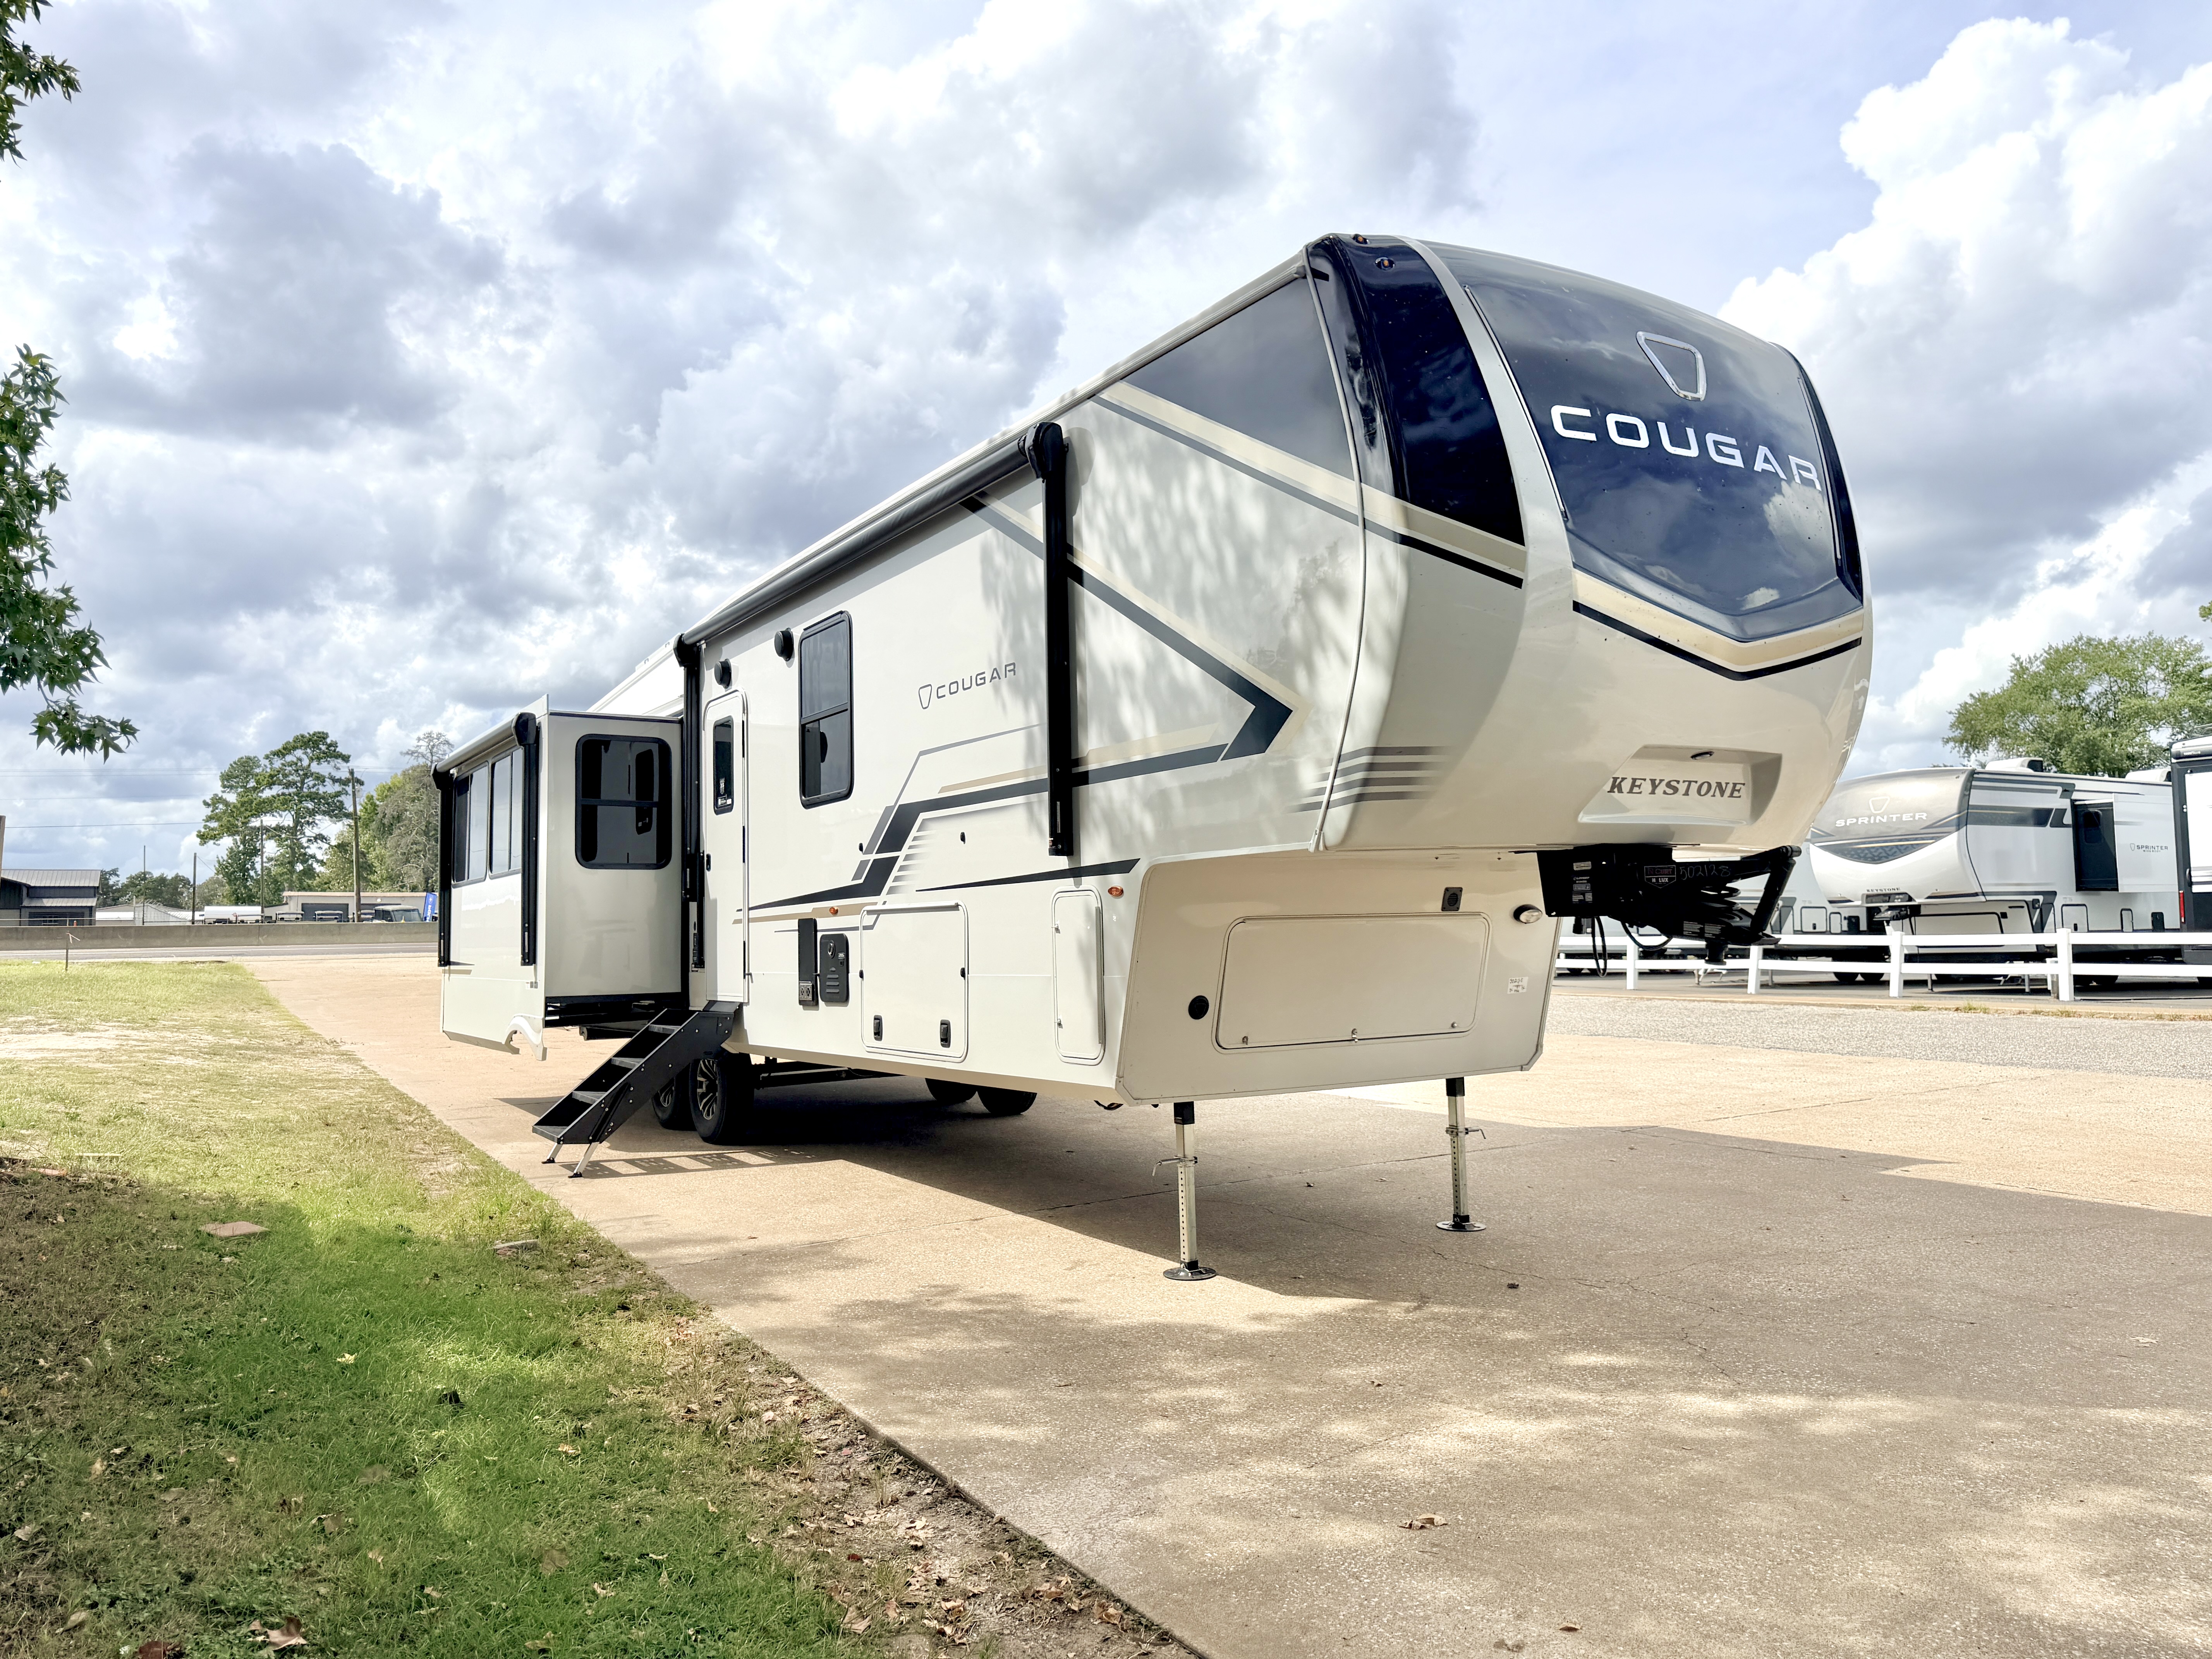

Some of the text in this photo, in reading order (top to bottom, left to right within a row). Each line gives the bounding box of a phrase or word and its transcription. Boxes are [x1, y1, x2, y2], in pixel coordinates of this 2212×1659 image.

[1551, 405, 1822, 492] COUGAR
[936, 662, 1017, 699] COUGAR
[1607, 776, 1746, 799] KEYSTONE
[1835, 812, 1927, 827] SPRINTER
[1680, 864, 1731, 880] 502128
